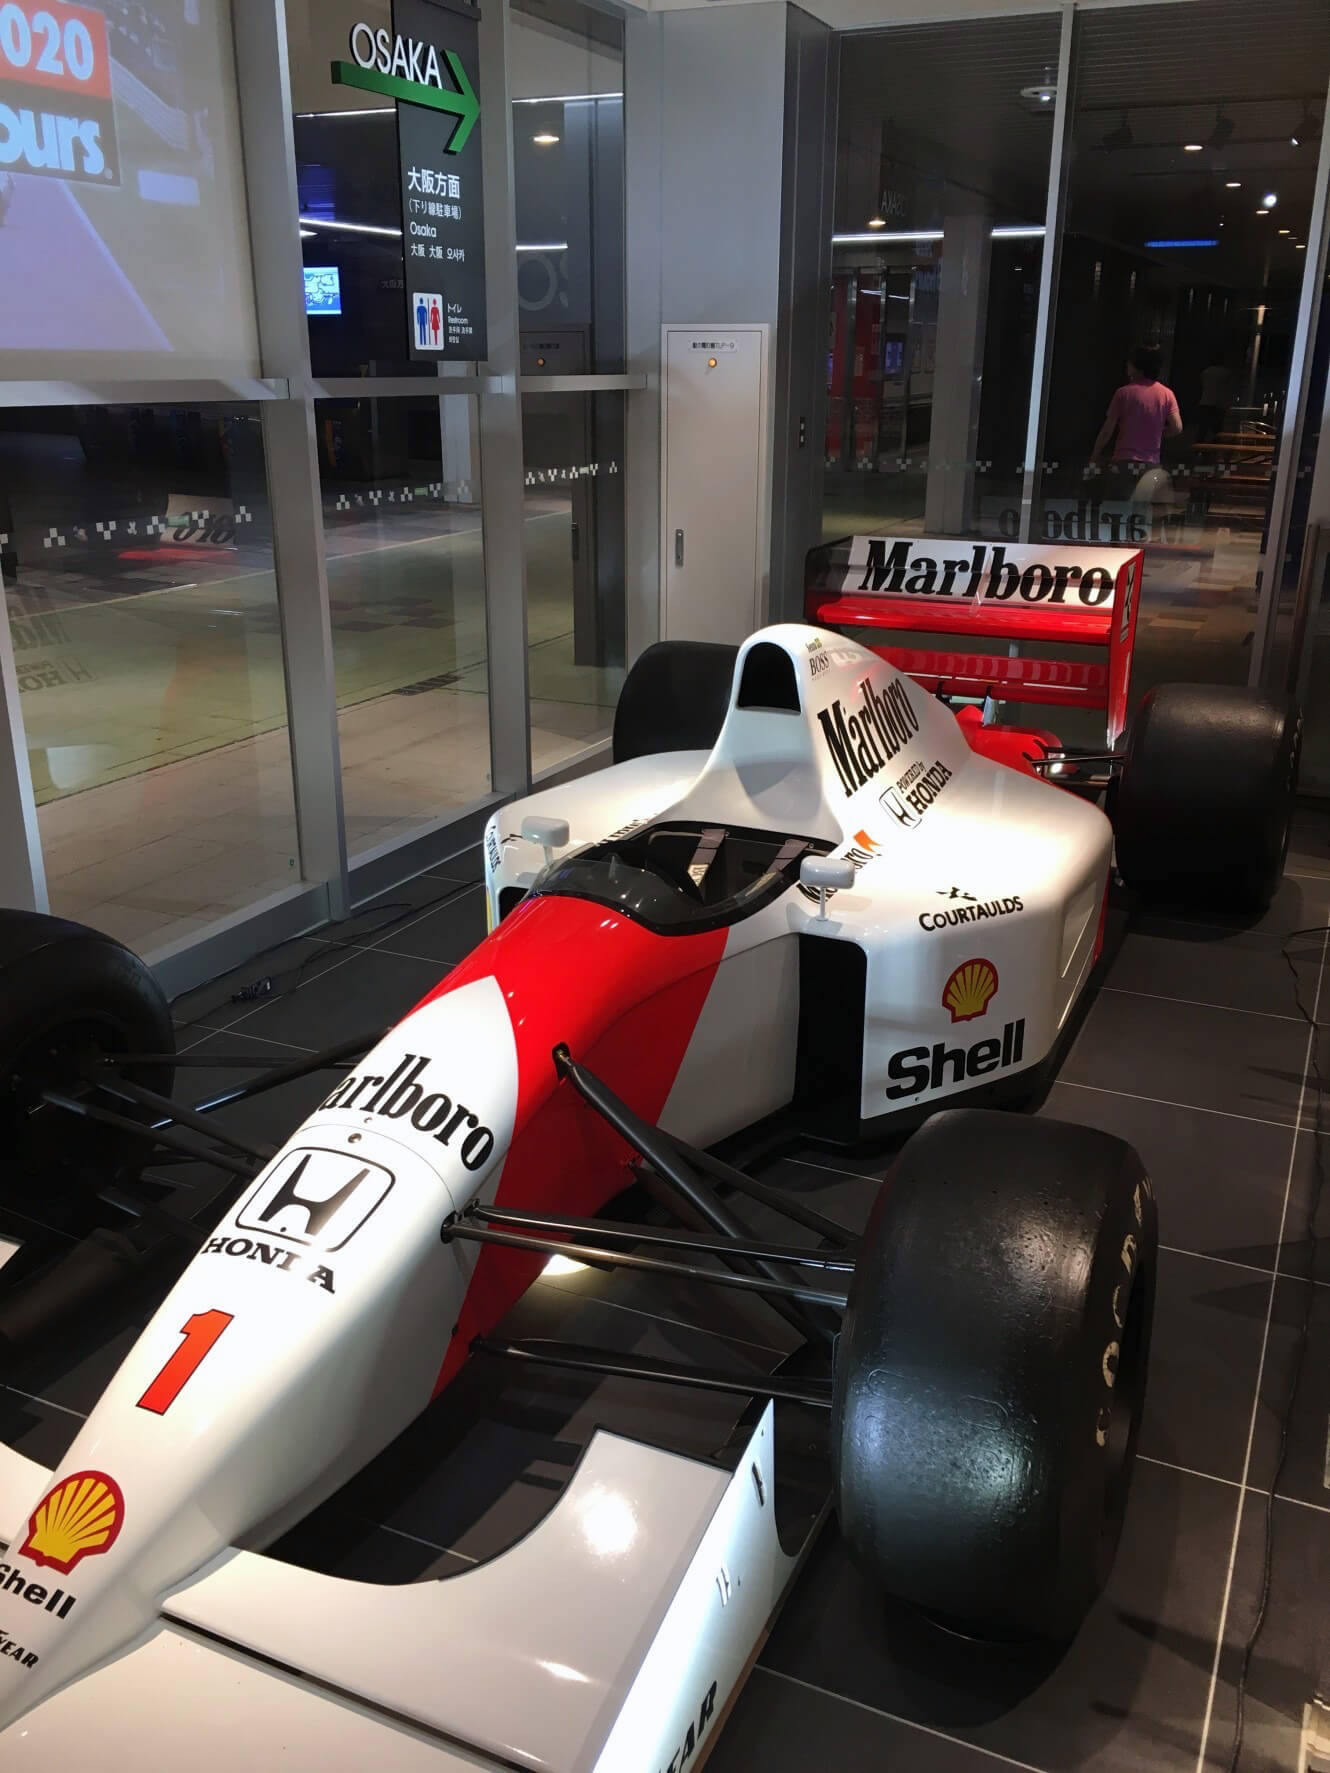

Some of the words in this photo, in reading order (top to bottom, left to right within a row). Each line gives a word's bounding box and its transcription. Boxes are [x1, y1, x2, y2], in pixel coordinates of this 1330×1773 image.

[351, 22, 443, 90] OSAKA
[407, 166, 461, 199] 大阪方面
[409, 221, 437, 238] Osaka
[858, 539, 1114, 607] Marlboro
[809, 650, 830, 676] BOSS
[817, 677, 919, 798] Marlboro
[905, 760, 953, 816] HONDA
[918, 896, 1024, 932] COURTAULDS
[885, 1018, 1026, 1101] Shell
[136, 1308, 235, 1417] 1
